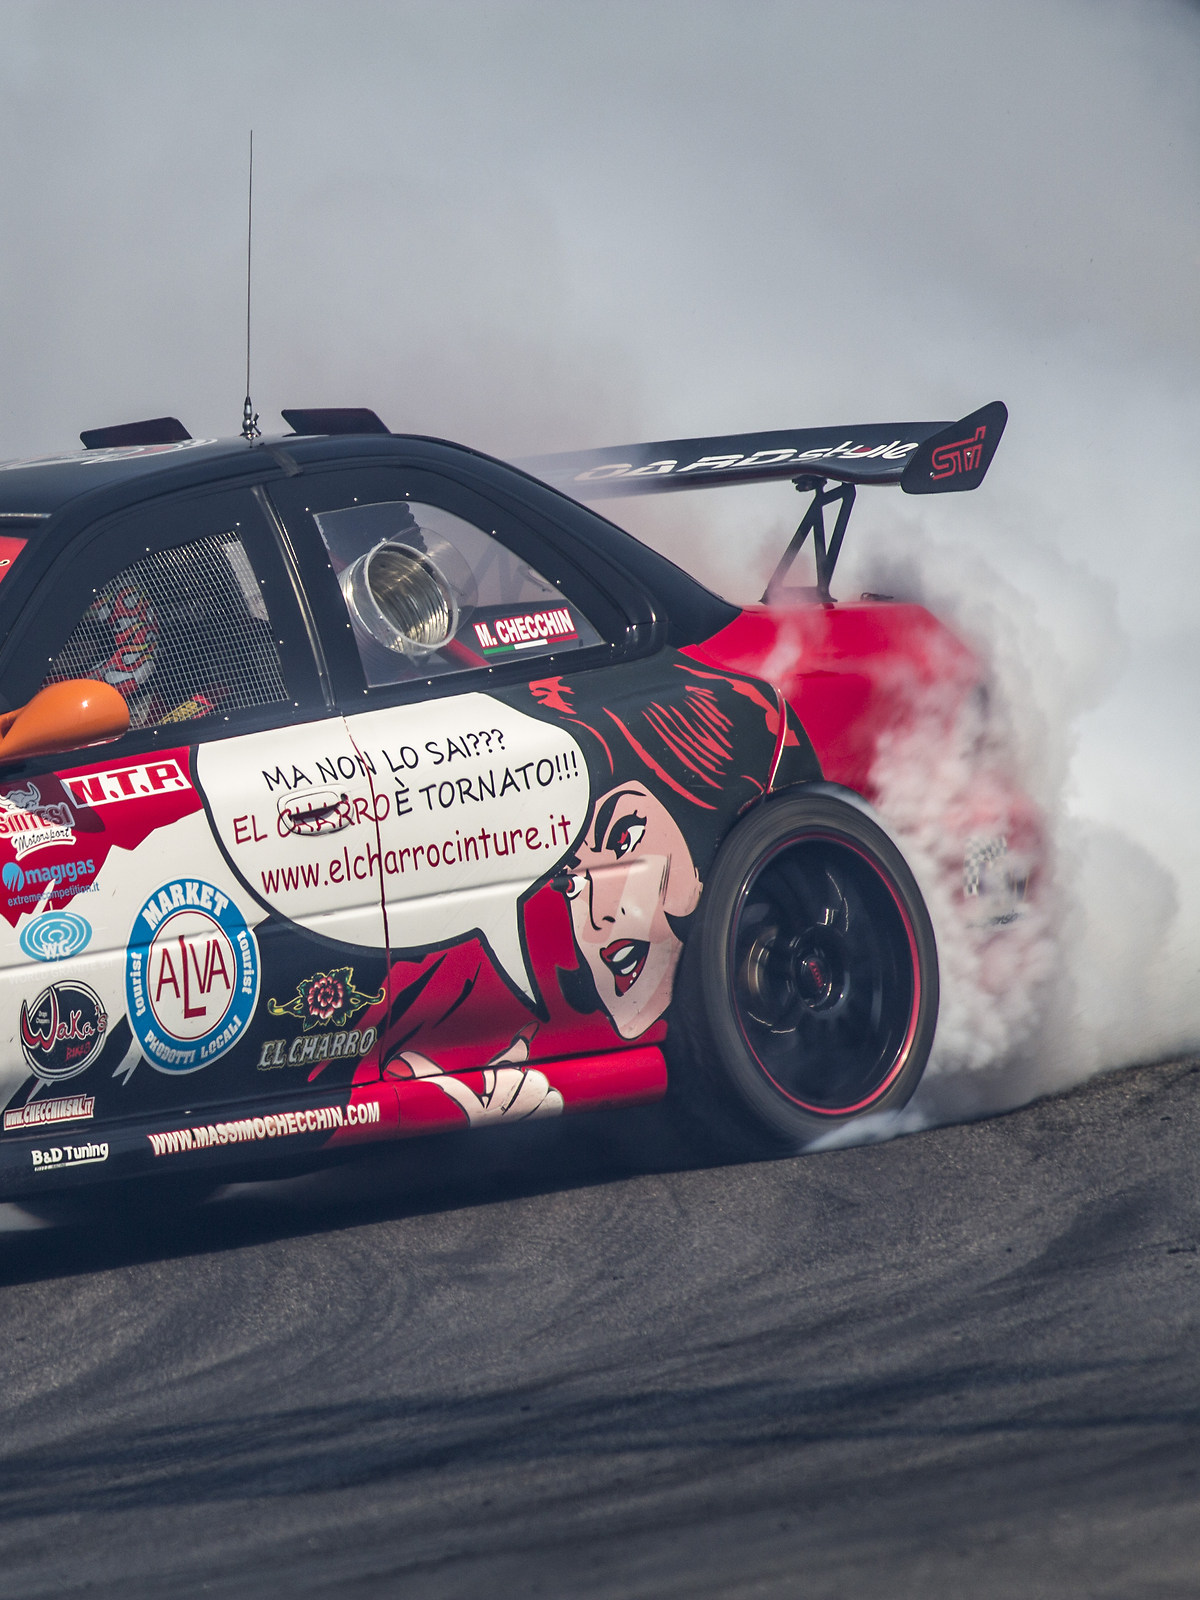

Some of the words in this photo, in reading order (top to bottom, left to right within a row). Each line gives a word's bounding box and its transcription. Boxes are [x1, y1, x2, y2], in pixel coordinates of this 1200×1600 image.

[474, 623, 498, 647] M.
[495, 608, 576, 644] CHECCHIN
[68, 762, 186, 803] N.T.P.
[262, 765, 313, 792] MA
[315, 751, 377, 784] NON
[382, 746, 419, 773] LO
[425, 728, 506, 765] SAI???
[233, 814, 268, 844] EL
[394, 776, 413, 816] È
[418, 750, 580, 811] TORNATO!!!
[14, 828, 70, 852] Motorsport
[261, 813, 572, 894] www.elcharrocinture.it
[7, 882, 100, 907] extremecompetition.it
[25, 859, 96, 885] magigas
[141, 881, 230, 931] MARKET
[129, 951, 146, 1018] tourist
[236, 930, 253, 996] tourist
[144, 1029, 197, 1065] PRODOTTI
[200, 1014, 243, 1060] LOCALI
[257, 1041, 285, 1071] EL
[286, 1026, 378, 1066] CHARRO
[148, 1101, 380, 1156] WWW.MASSIMOCHECCHIN.COM
[31, 1146, 63, 1166] B&D
[63, 1142, 109, 1161] Tuning
